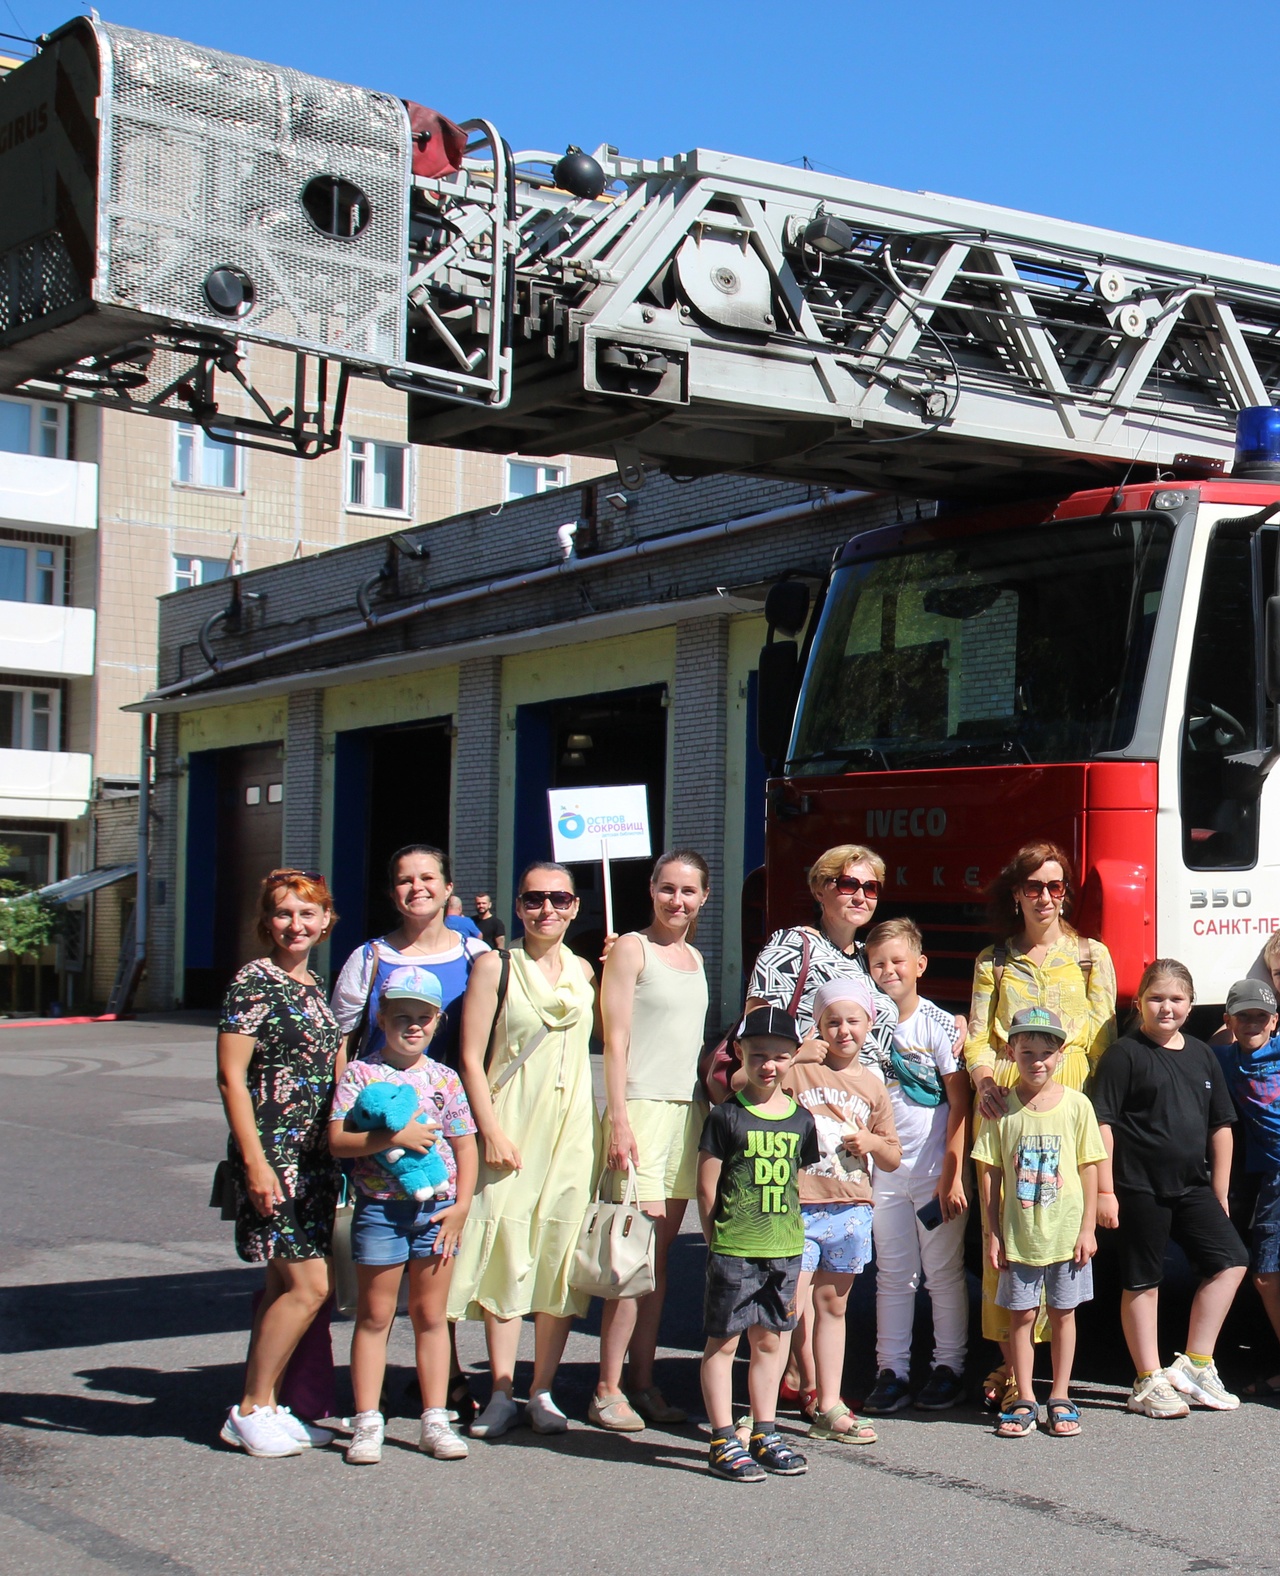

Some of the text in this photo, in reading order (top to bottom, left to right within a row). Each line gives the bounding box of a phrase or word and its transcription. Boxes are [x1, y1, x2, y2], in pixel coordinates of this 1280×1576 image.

[587, 815, 625, 825] ОСТРОВ
[588, 822, 644, 834] СОКРОВИЩ
[866, 807, 947, 837] IVECO
[1189, 888, 1252, 909] 350
[798, 1086, 848, 1108] FRIENDS
[743, 1130, 800, 1159] JUST
[1020, 1135, 1061, 1152] MALIBU
[754, 1157, 791, 1186] DO
[761, 1185, 788, 1213] IT.
